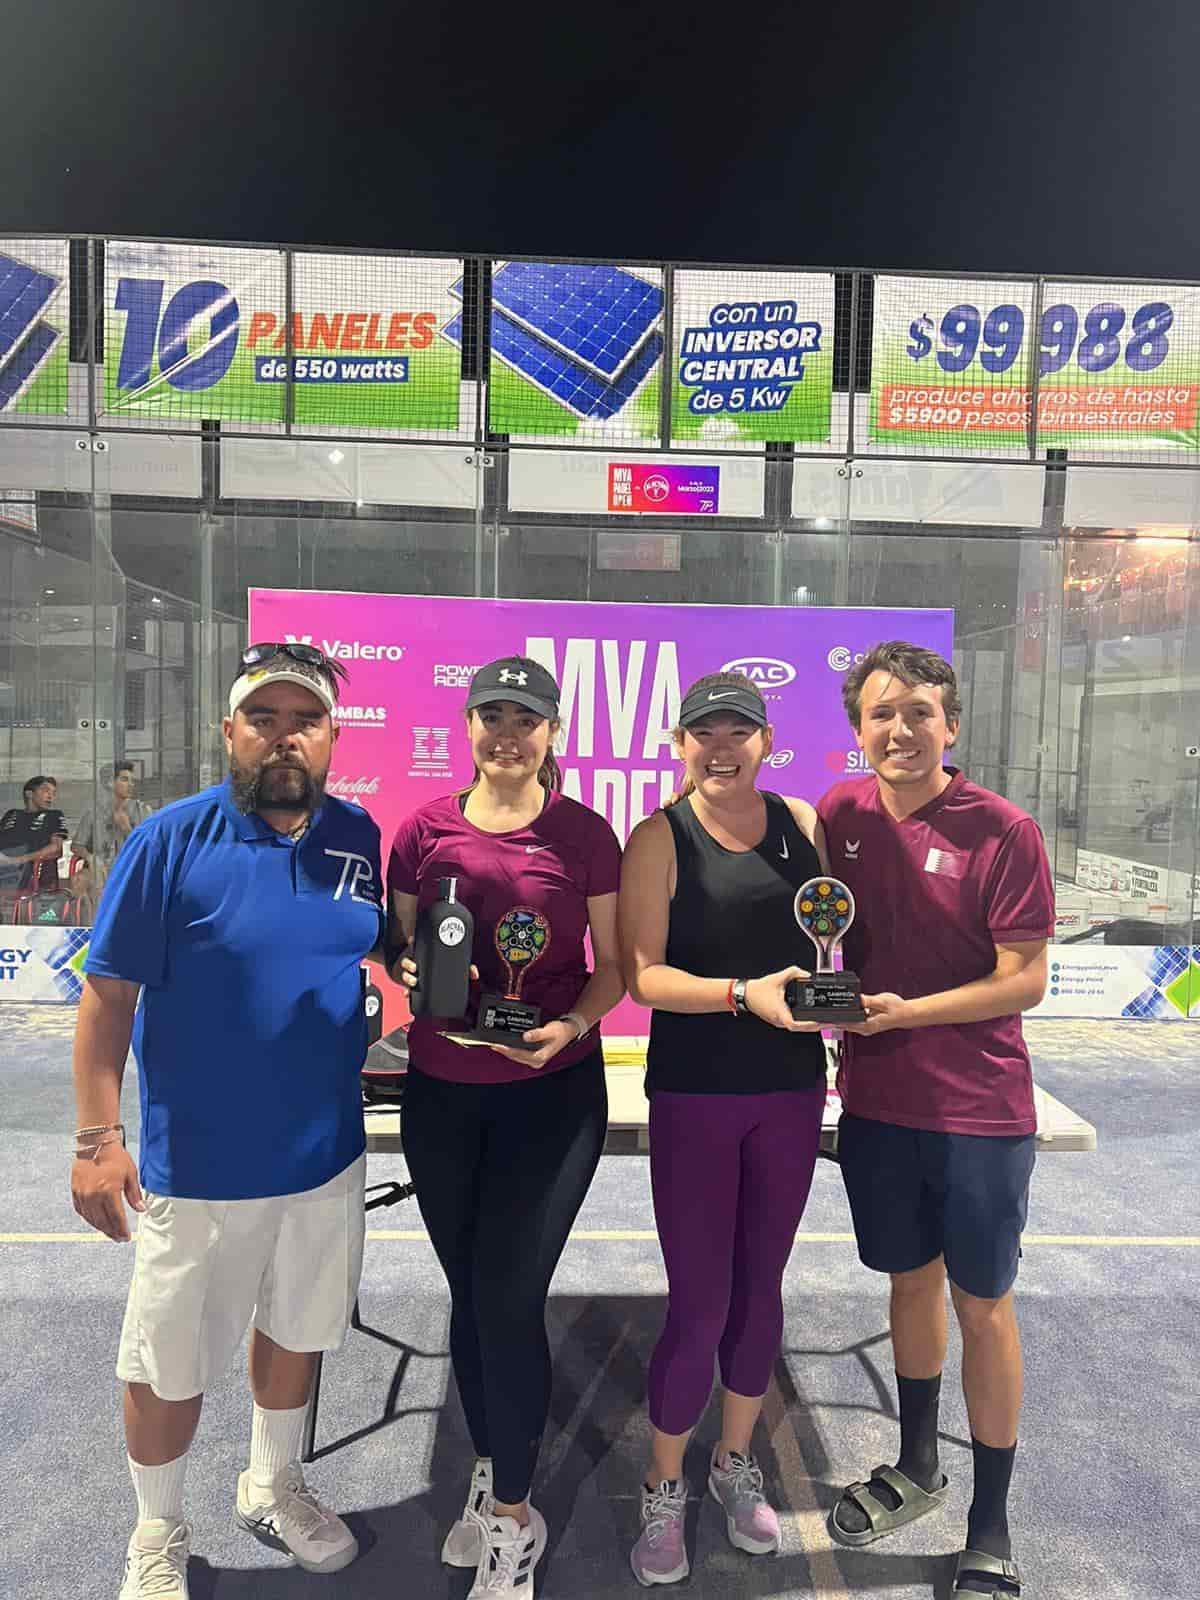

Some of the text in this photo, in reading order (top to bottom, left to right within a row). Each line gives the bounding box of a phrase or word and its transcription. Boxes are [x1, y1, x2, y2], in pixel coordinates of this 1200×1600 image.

[713, 305, 793, 324] con un
[115, 278, 240, 391] 10
[246, 311, 437, 350] PANELES
[686, 326, 818, 353] INVERSOR
[261, 360, 405, 379] de 550 watts
[684, 356, 800, 381] CENTRAL
[693, 387, 786, 410] de 5 Kw
[889, 387, 1191, 410] produce ahorros de hasta
[889, 406, 1176, 429] $5900 pesos bimestrales
[322, 640, 403, 661] Valero
[526, 637, 683, 759] MVA
